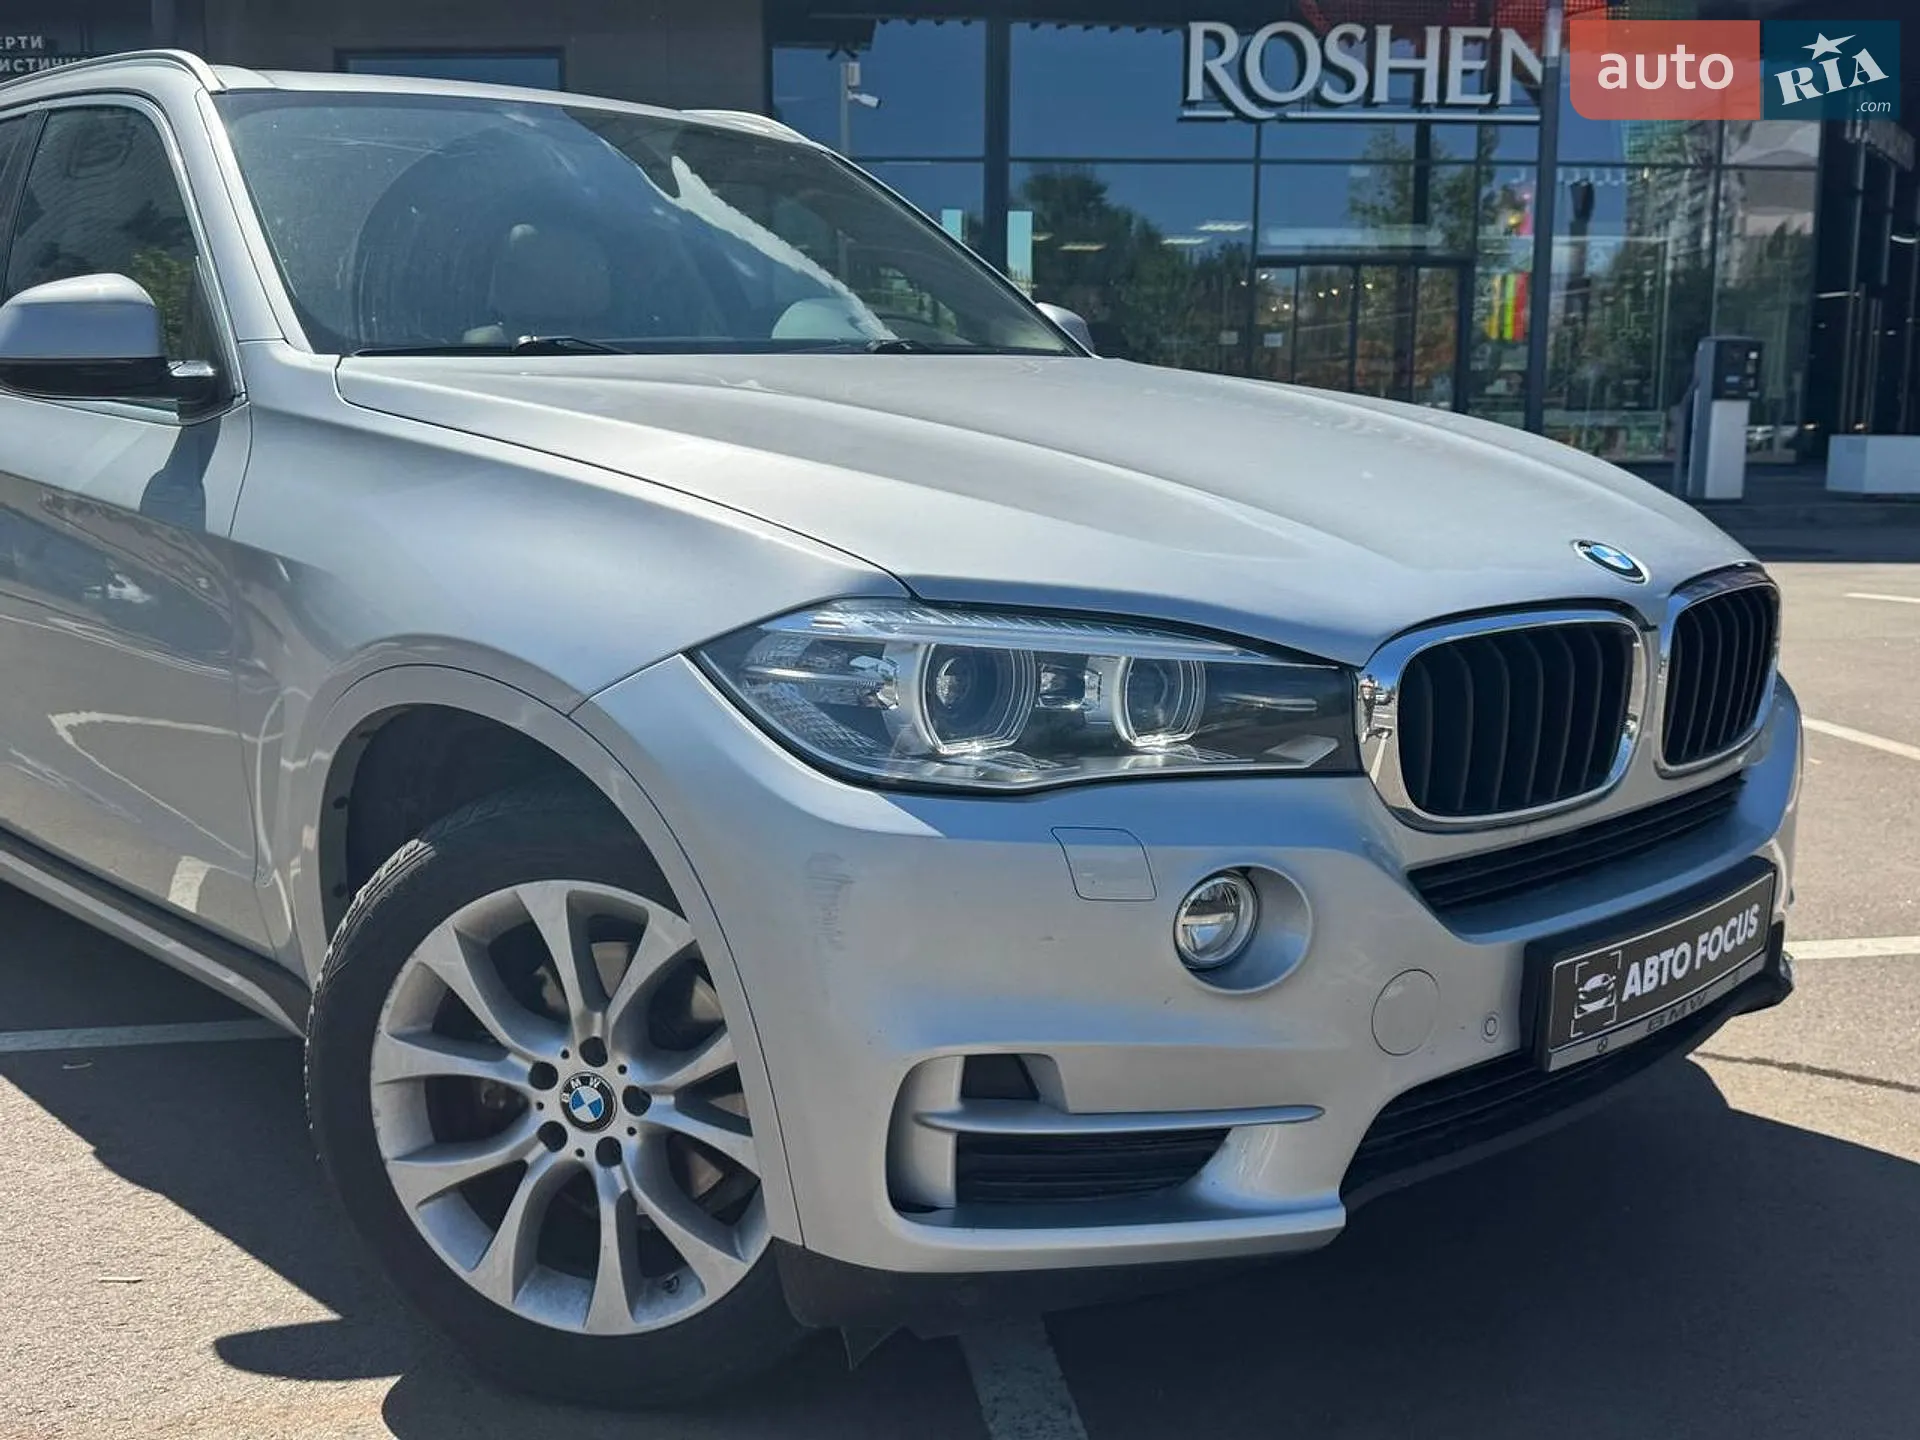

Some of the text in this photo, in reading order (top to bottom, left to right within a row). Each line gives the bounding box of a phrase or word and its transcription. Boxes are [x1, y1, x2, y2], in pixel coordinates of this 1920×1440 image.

[1186, 21, 1543, 119] ROSHEN
[1694, 902, 1760, 970] FOCUS
[561, 1077, 601, 1104] BMW
